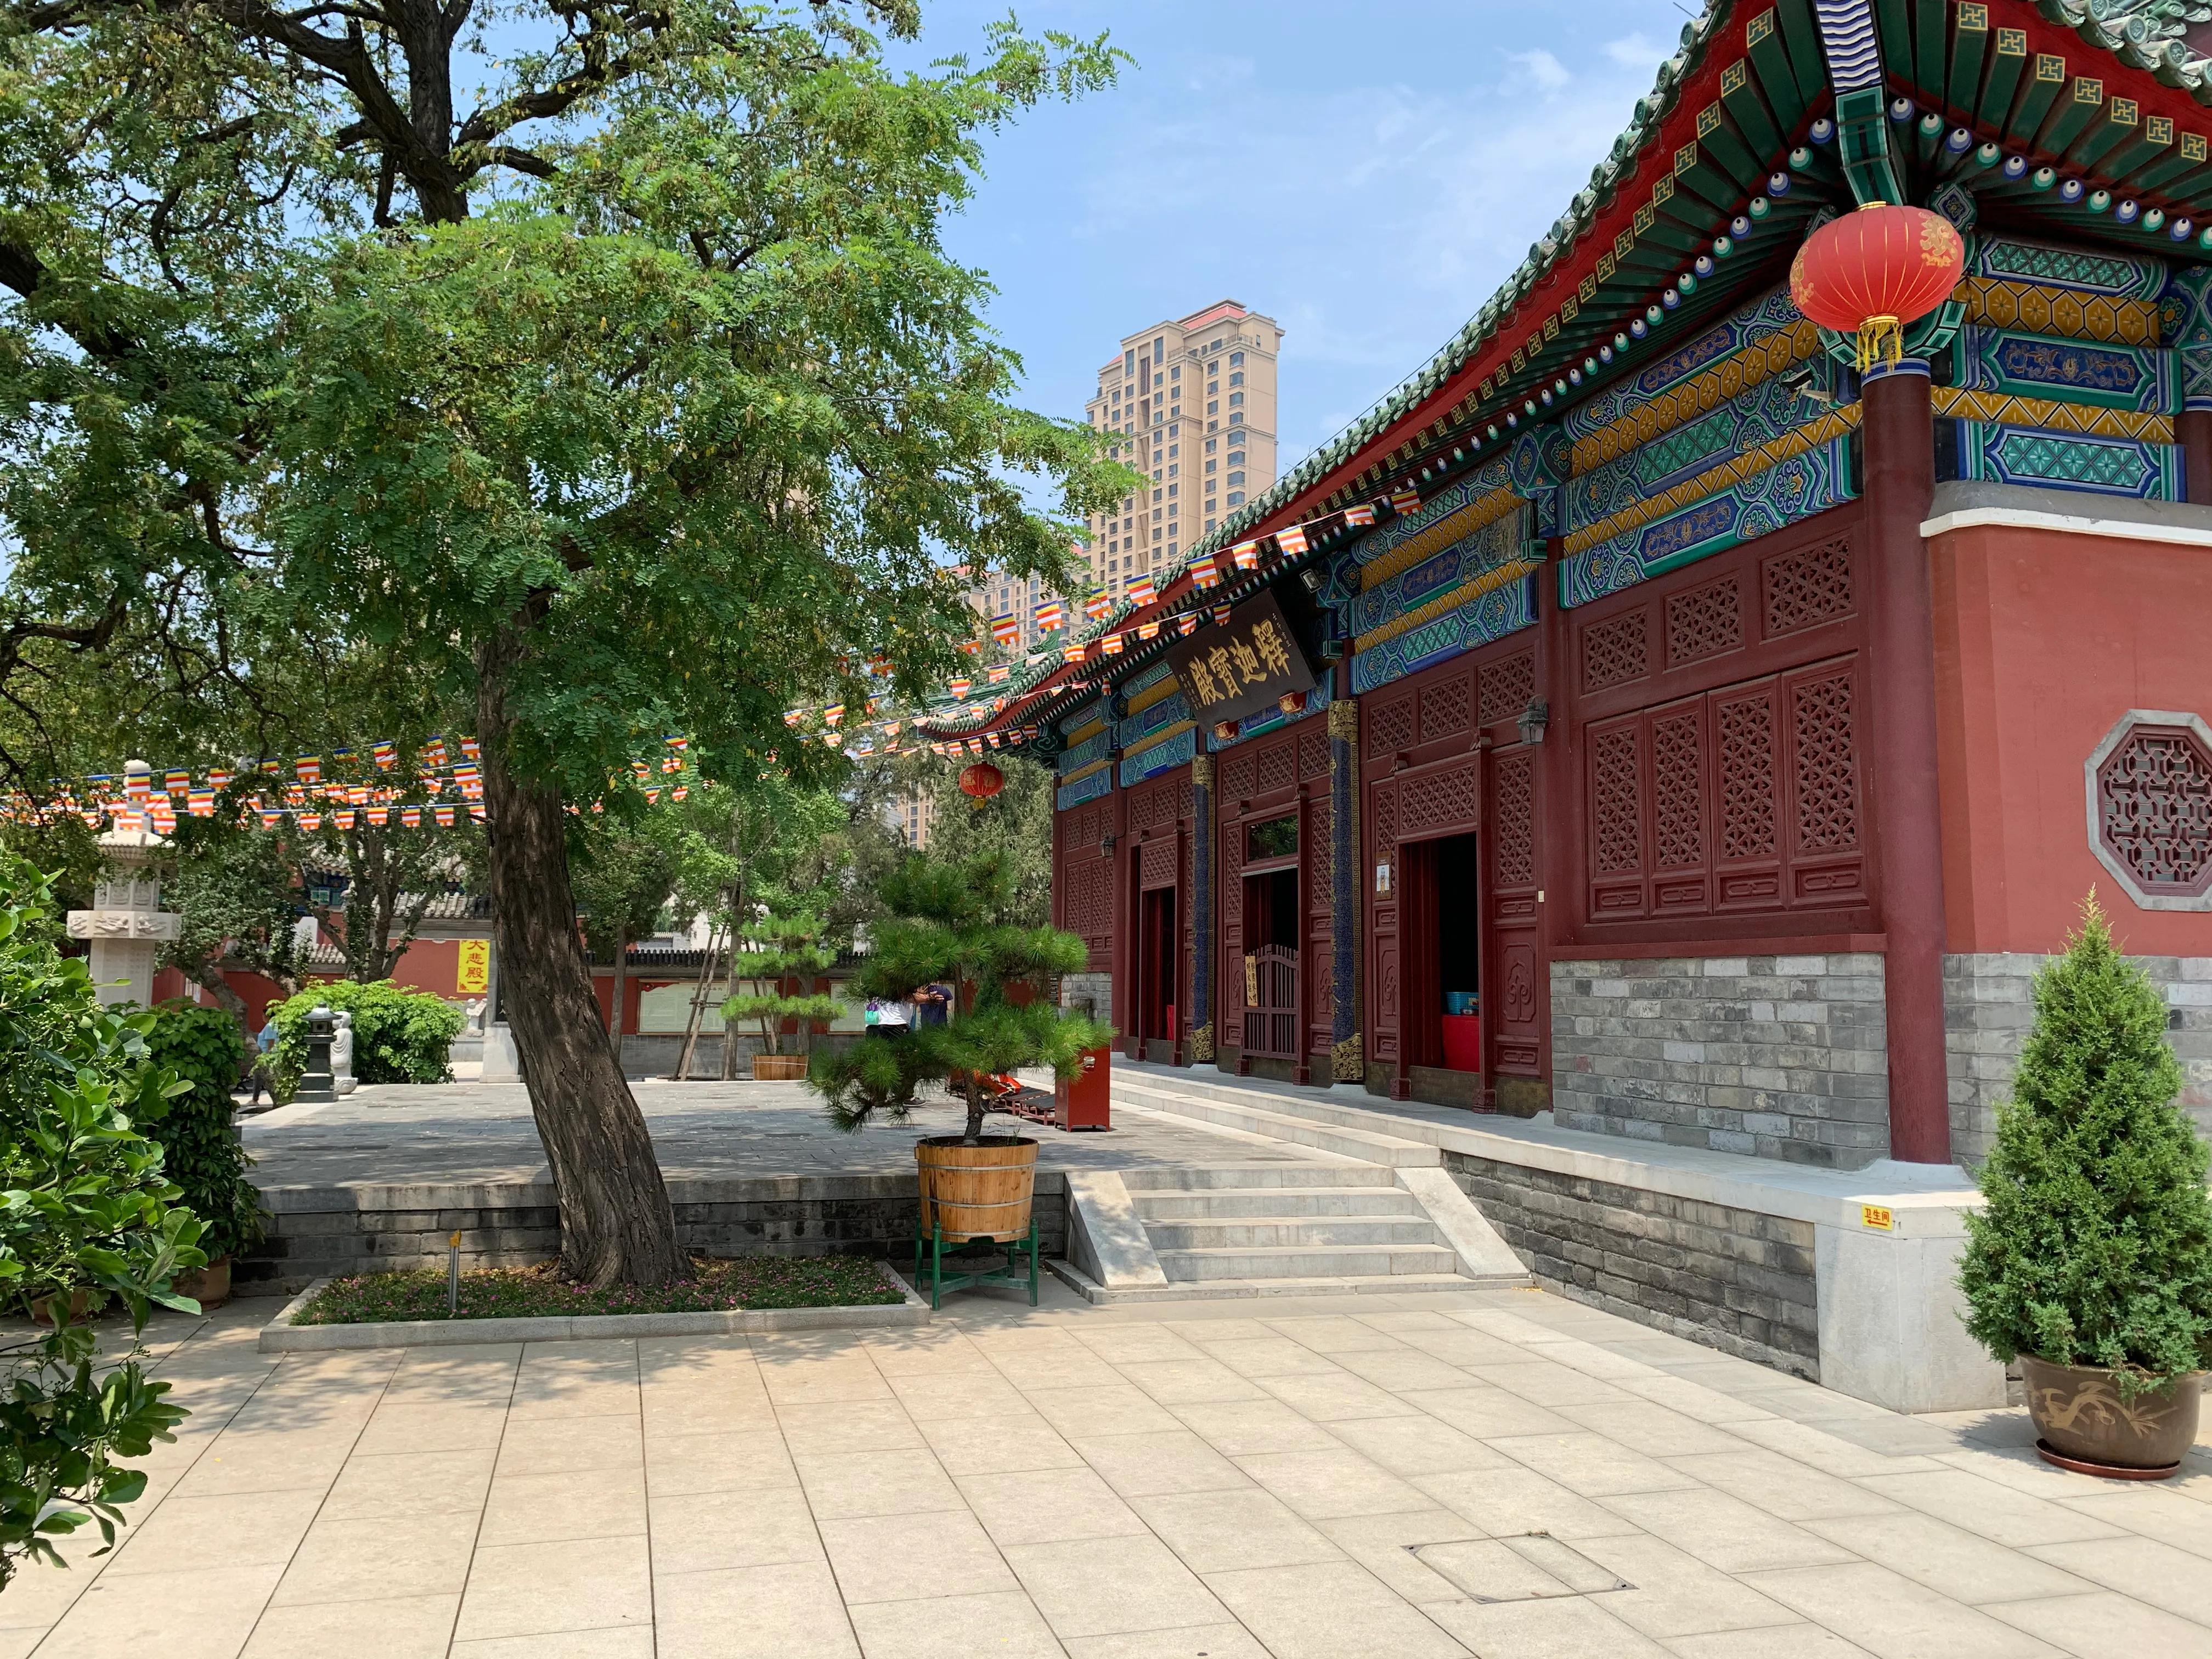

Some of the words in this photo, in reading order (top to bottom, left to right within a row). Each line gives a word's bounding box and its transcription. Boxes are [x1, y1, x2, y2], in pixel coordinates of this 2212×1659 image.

[465, 940, 485, 979] 大悲殿
[1864, 1208, 1889, 1222] 卫生间
